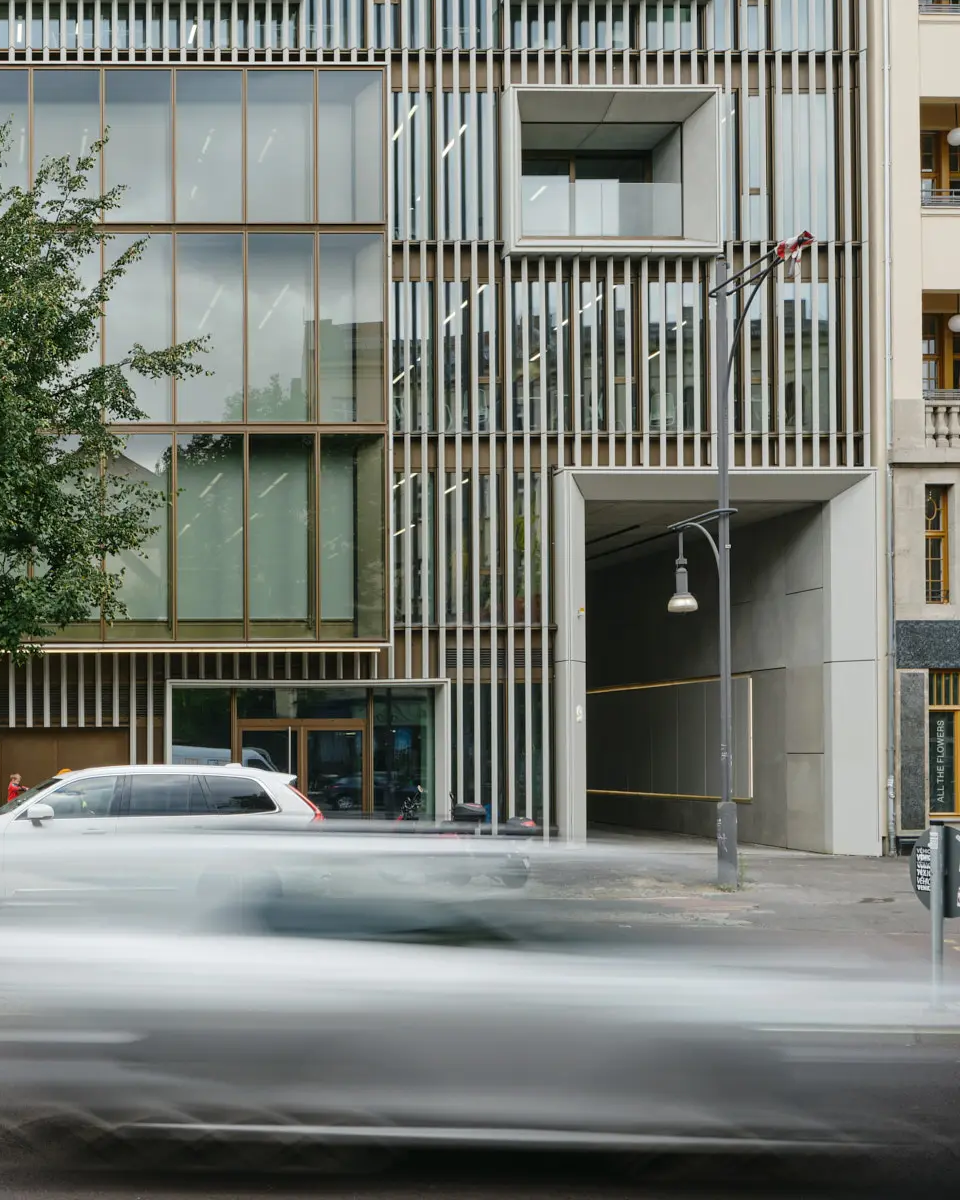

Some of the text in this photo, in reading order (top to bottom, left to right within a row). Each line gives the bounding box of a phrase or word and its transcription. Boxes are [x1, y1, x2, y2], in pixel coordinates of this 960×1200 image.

[936, 720, 945, 803] ALL THE FLOWERS
